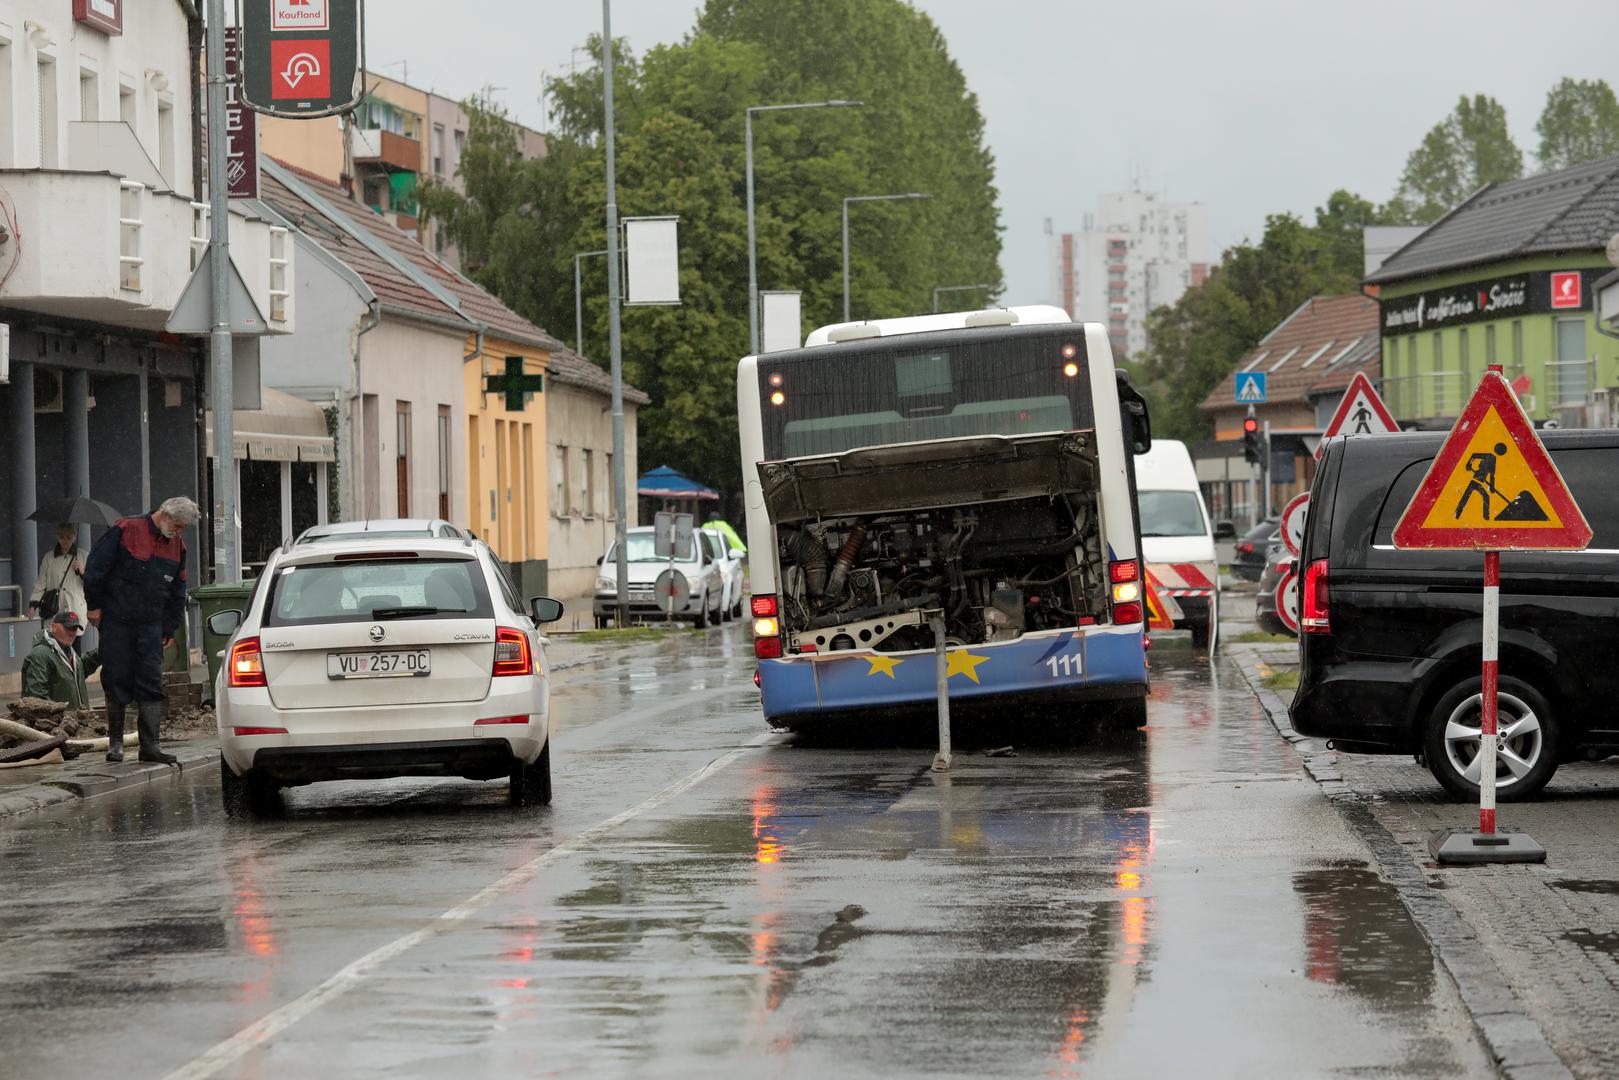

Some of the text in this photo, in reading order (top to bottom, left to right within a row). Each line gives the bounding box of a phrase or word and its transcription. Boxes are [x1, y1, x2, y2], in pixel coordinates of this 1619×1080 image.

[279, 10, 321, 19] Kaufland
[339, 656, 358, 672] VU
[1046, 653, 1083, 677] 111
